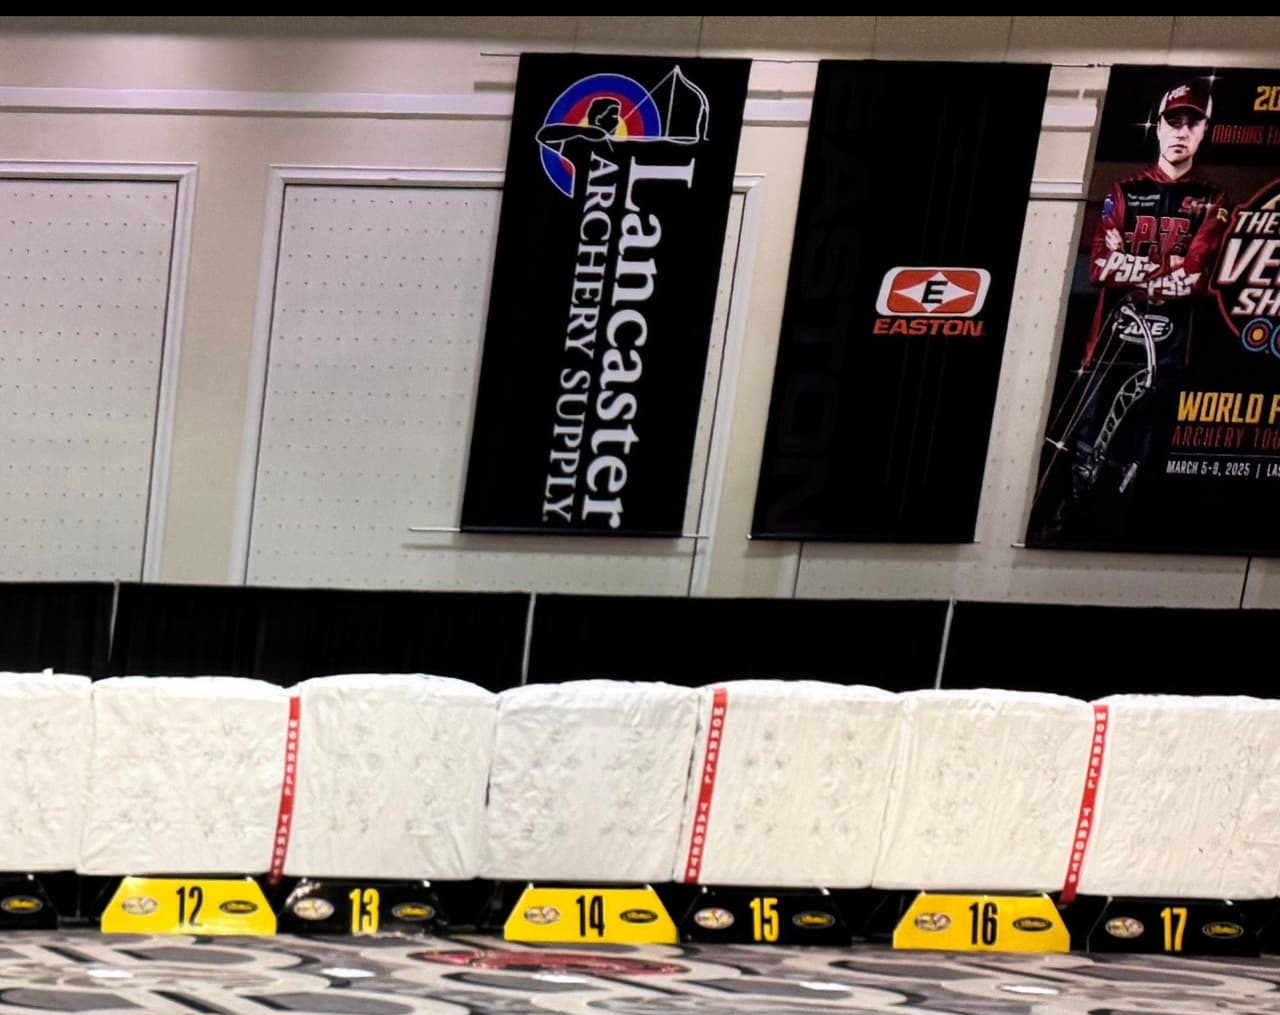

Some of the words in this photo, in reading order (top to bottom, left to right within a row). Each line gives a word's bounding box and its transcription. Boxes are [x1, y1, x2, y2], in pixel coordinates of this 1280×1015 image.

[564, 151, 620, 360] ARCHERY
[1099, 251, 1150, 282] PSE
[921, 280, 949, 304] E
[582, 156, 696, 529] Lancaster
[872, 318, 984, 337] EASTON
[1177, 391, 1265, 423] WORLD
[542, 368, 592, 522] SUPPLY
[1171, 425, 1246, 448] ARCHERY
[1166, 460, 1199, 474] MARCH
[1200, 461, 1222, 476] 5-9,
[1225, 461, 1251, 476] 2025
[284, 719, 298, 796] MORRELL
[703, 706, 724, 783] MORRELL
[1086, 711, 1107, 789] MORRELL
[687, 802, 710, 878] TARGETS
[1068, 807, 1091, 883] TARGETS
[176, 885, 204, 928] 12
[348, 887, 380, 934] 13
[576, 895, 605, 938] 14
[749, 896, 780, 942] 15
[968, 901, 998, 946] 16
[1160, 907, 1187, 951] 17
